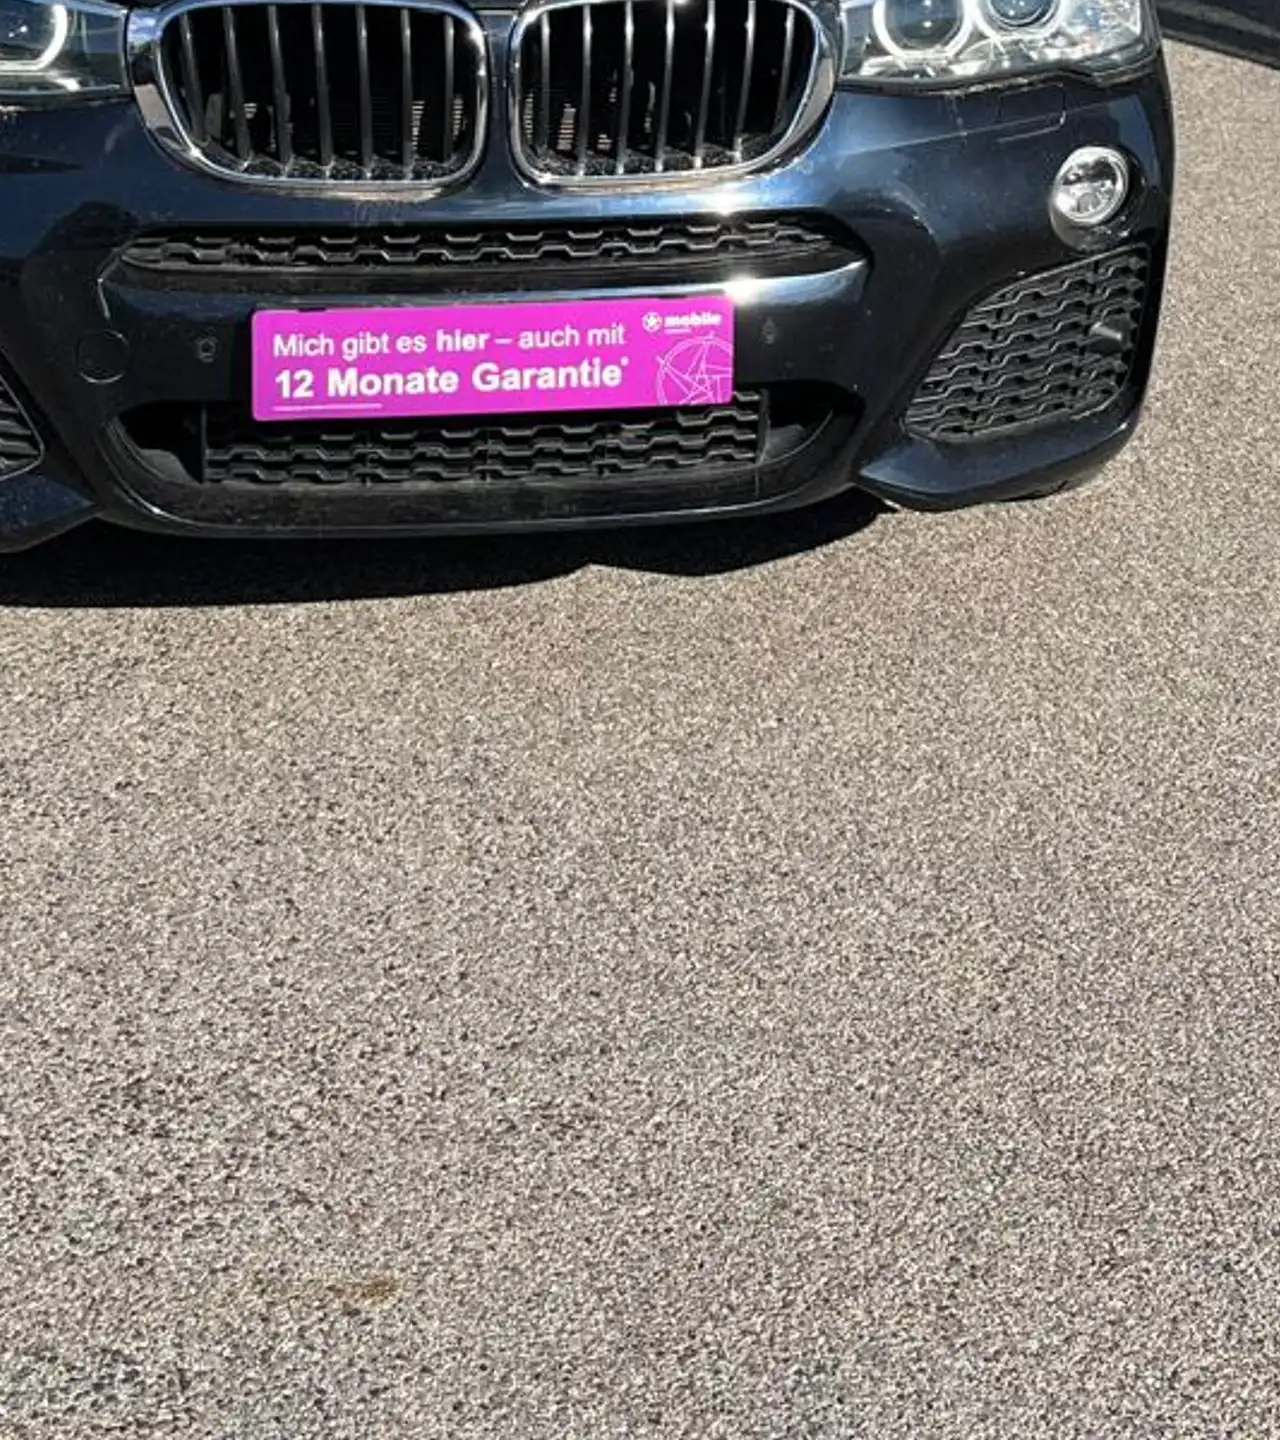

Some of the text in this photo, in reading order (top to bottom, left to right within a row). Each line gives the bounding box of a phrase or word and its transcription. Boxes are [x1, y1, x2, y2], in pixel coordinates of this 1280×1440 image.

[272, 332, 335, 357] Mich
[341, 330, 391, 362] gibt
[395, 334, 428, 354] es
[435, 327, 490, 353] hier
[518, 324, 580, 350] auch
[587, 322, 627, 346] mit
[275, 368, 315, 399] 12
[326, 366, 460, 398] Monate
